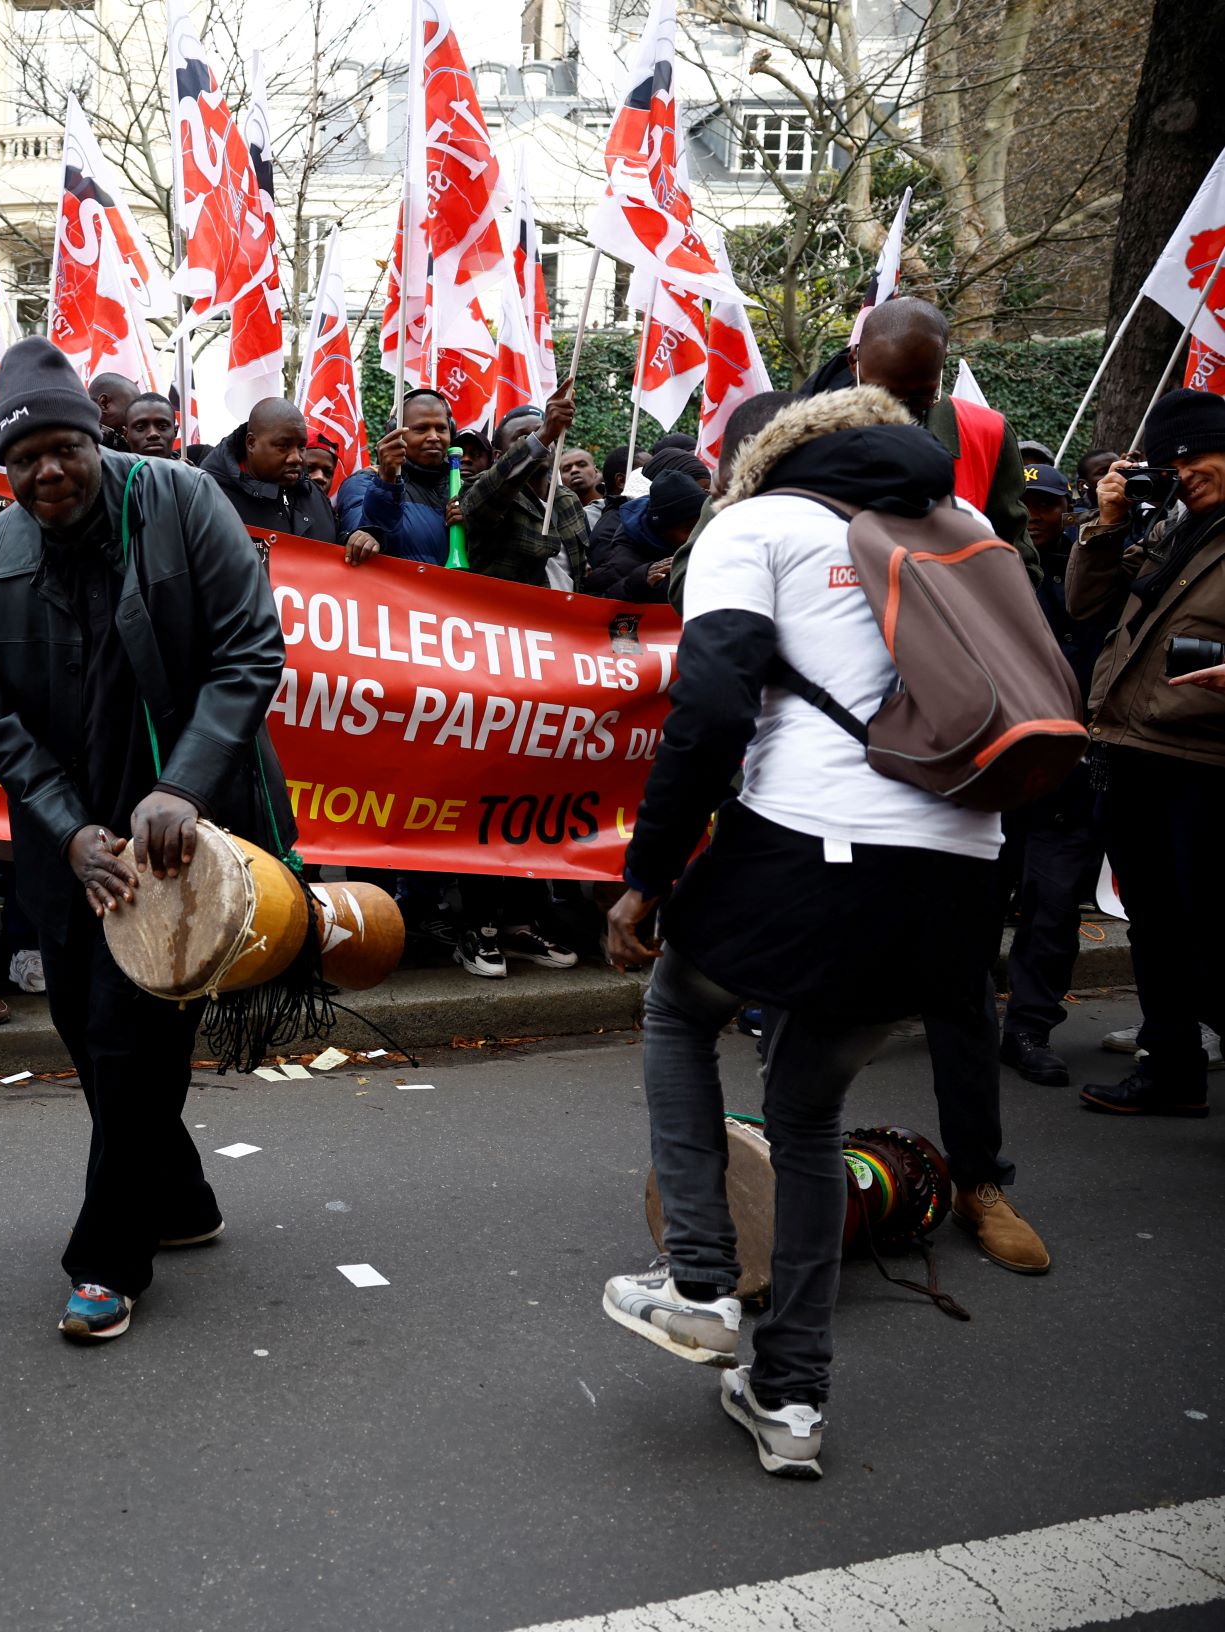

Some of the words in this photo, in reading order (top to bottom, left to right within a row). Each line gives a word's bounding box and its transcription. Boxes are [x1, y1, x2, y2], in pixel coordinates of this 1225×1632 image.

[832, 567, 859, 585] LOG
[273, 586, 556, 681] COLLECTIF
[573, 653, 640, 691] DES
[647, 644, 678, 693] T
[265, 667, 621, 761] ANS-PAPIERS
[286, 779, 396, 828] TION
[403, 797, 467, 832] DE
[478, 791, 600, 845] TOUS
